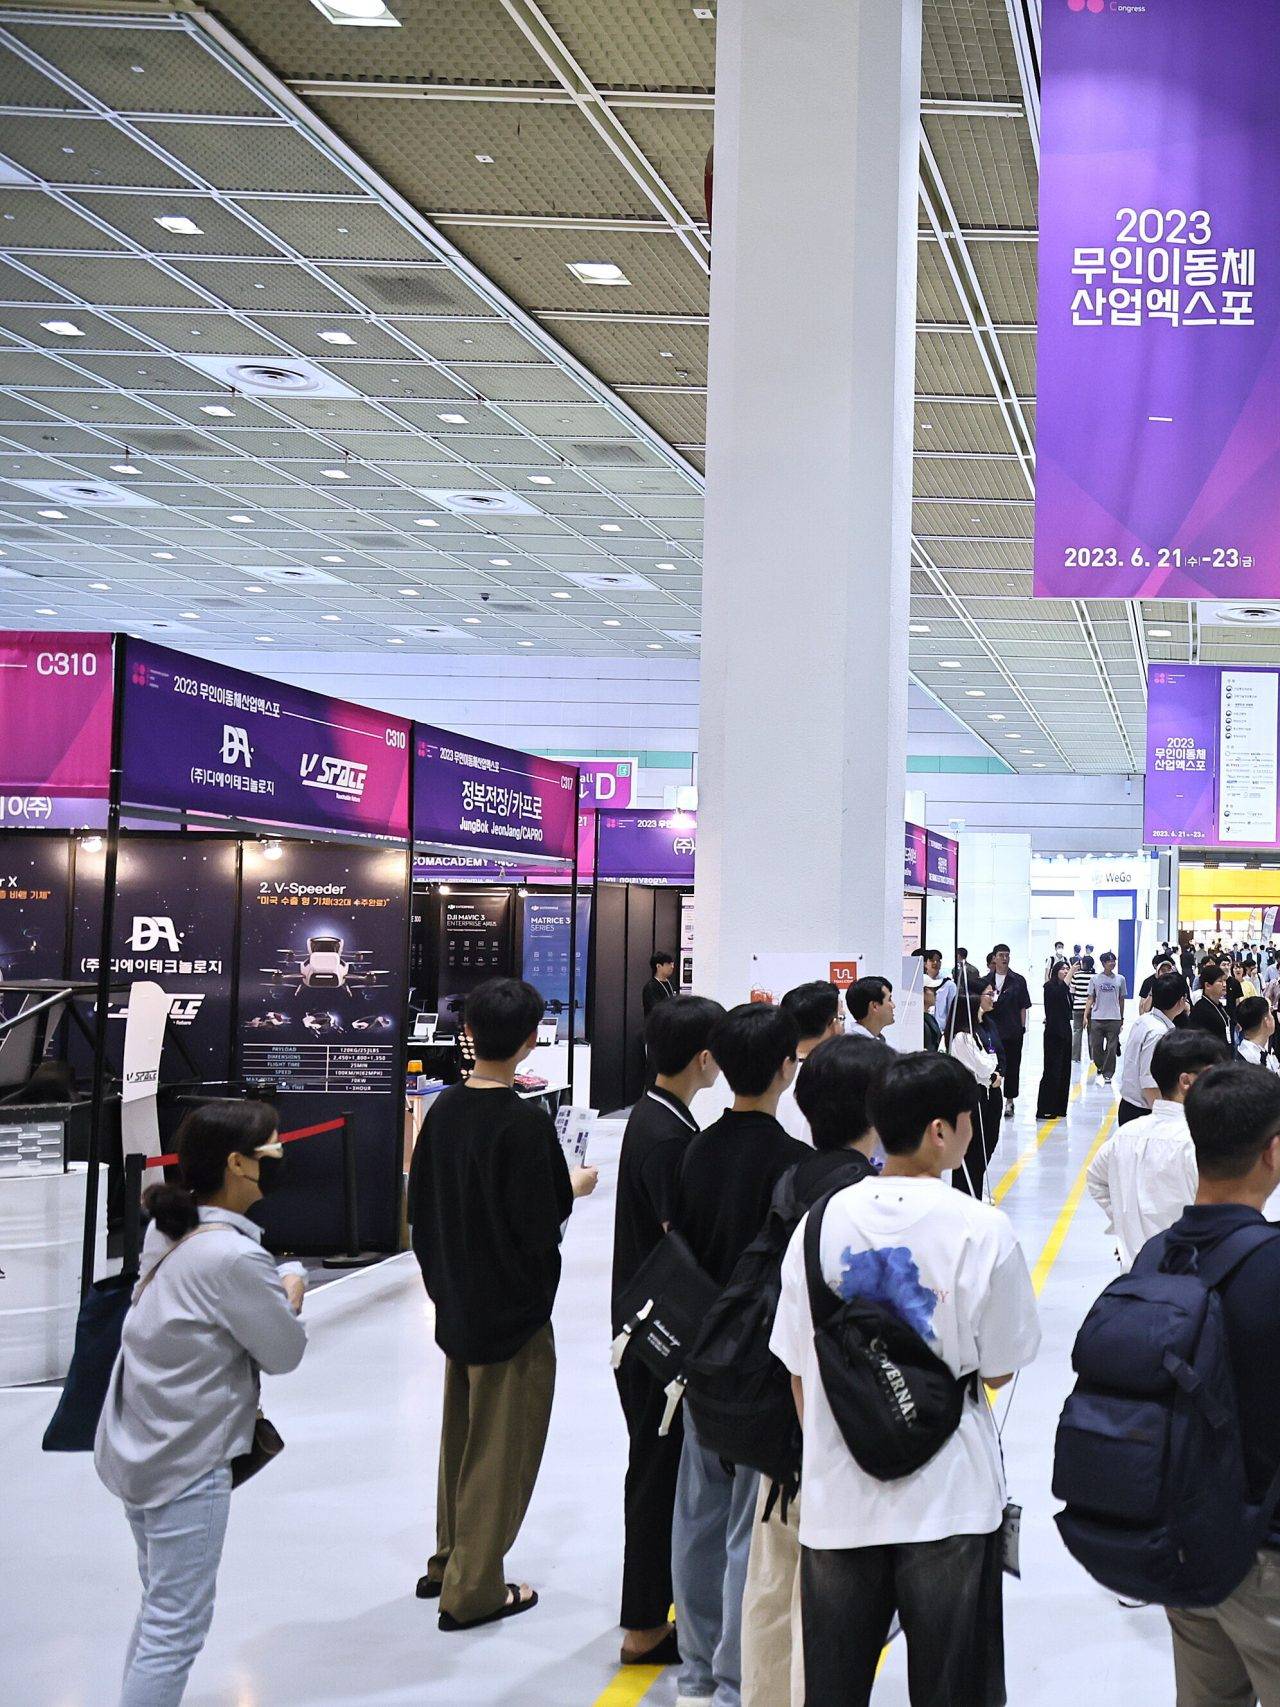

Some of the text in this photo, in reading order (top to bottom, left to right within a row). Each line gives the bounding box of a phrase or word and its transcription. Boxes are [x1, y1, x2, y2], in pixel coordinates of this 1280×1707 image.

[1115, 207, 1212, 245] 2023
[1071, 246, 1255, 287] 무인이동체
[1070, 287, 1255, 328] 산업엑스포
[1064, 547, 1124, 567] 2023.
[1130, 548, 1150, 567] 6.
[36, 651, 97, 676] C310
[174, 676, 198, 697] 2023
[200, 683, 281, 718] 무인이동체산업엑스포
[386, 728, 406, 750] C310
[1166, 737, 1195, 749] 2023
[1154, 748, 1207, 760] 무인이동체
[1154, 759, 1207, 771] 산업엑스포
[190, 767, 275, 796] (주)디에이테크놀로지
[595, 772, 616, 800] D
[461, 780, 543, 820] 정복전장/카프로
[637, 820, 657, 828] 2023
[1105, 871, 1132, 883] WeGo
[259, 882, 347, 896] 2. V-Speeder
[80, 957, 222, 974] (주디에이테크놀로지
